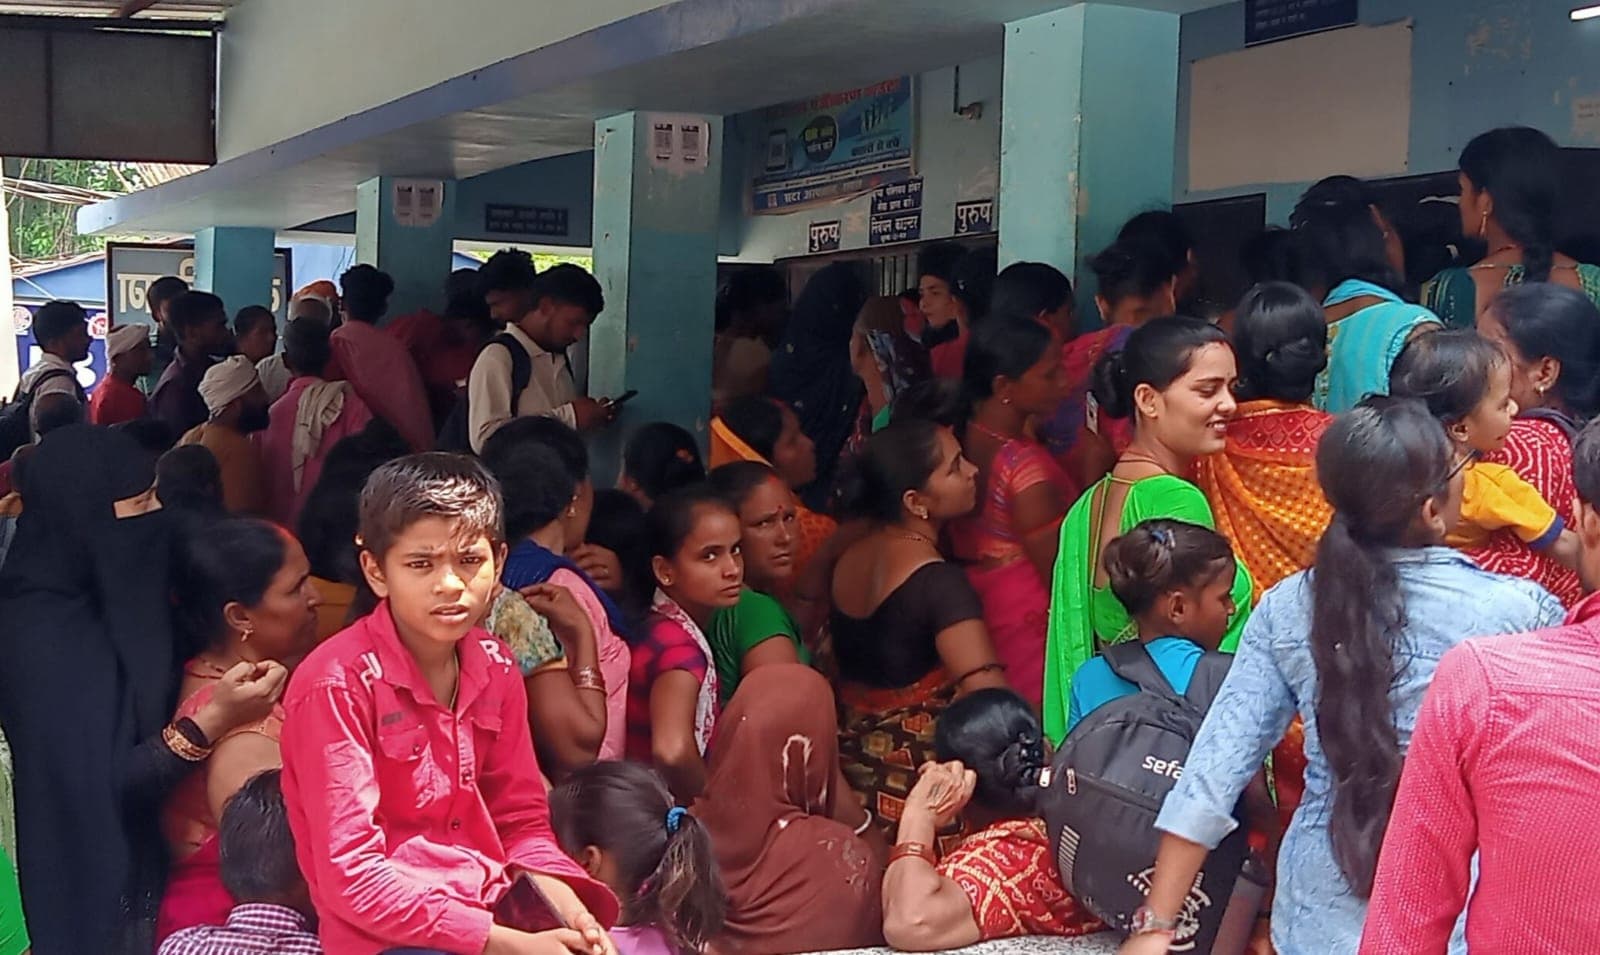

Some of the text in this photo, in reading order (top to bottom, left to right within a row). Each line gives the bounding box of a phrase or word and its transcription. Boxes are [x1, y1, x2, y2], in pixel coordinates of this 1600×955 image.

[957, 202, 993, 233] पुरुष
[811, 223, 840, 251] पुरुष
[1142, 756, 1185, 779] sefa
